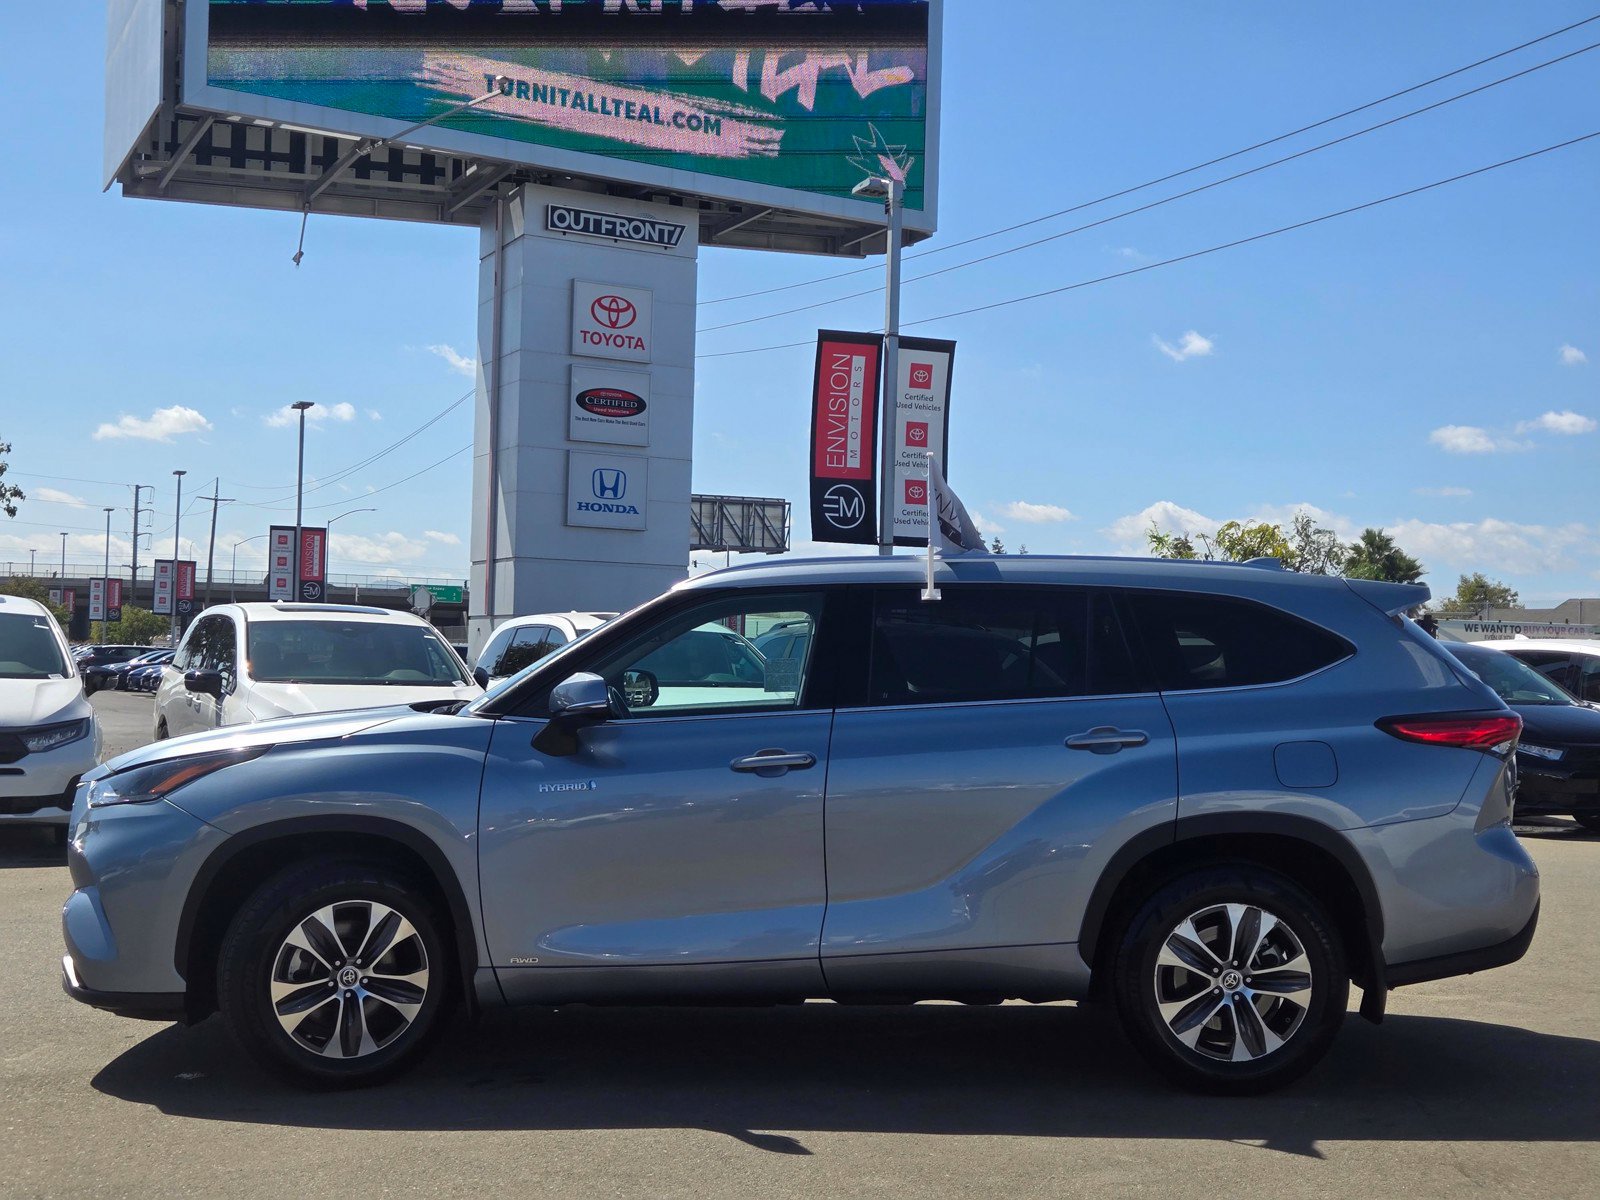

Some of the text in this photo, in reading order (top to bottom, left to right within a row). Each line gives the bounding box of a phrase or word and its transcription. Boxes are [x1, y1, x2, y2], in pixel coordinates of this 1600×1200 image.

[483, 73, 721, 136] TURNITALLTEAL.COM
[580, 330, 645, 350] TOYOTA
[904, 393, 934, 401] Certified
[827, 353, 851, 468] ENVISION
[850, 365, 863, 459] MOTORS
[914, 403, 942, 411] Vehicles
[577, 502, 639, 514] HONDA
[1464, 623, 1479, 633] WE
[1481, 624, 1509, 634] WANT
[1510, 625, 1522, 634] TO
[1523, 626, 1543, 635] BUY
[1543, 626, 1567, 636] YOUR
[539, 783, 587, 793] HYBRID
